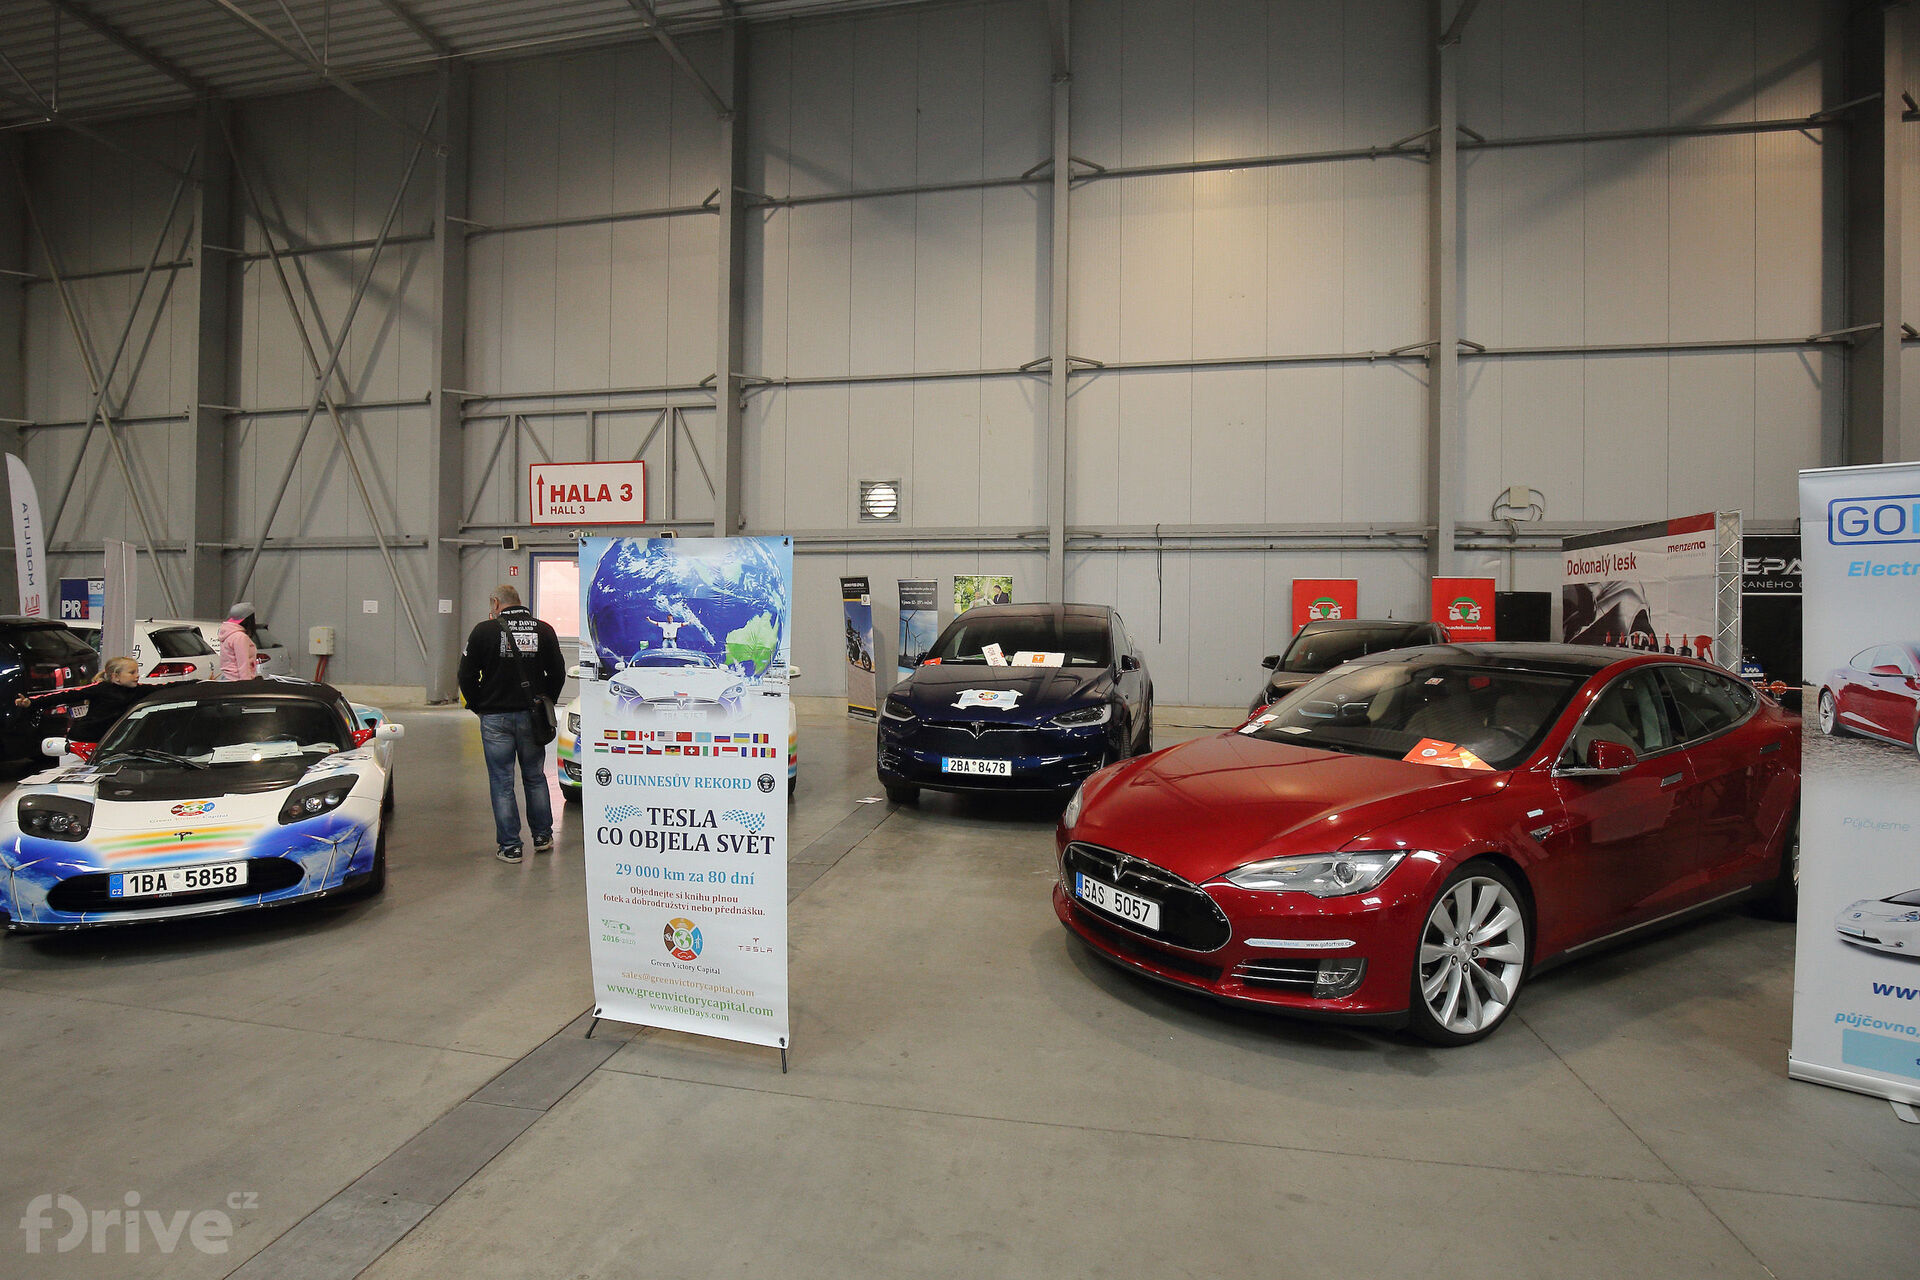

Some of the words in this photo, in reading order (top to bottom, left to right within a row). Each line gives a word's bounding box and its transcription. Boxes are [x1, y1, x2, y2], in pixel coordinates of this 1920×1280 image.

[550, 484, 612, 502] HALA
[620, 483, 633, 501] 3
[550, 505, 576, 514] HALL
[579, 505, 586, 514] 3
[1837, 503, 1920, 537] GO
[1667, 541, 1706, 553] menzerna
[1566, 552, 1610, 577] Dokonalý
[1612, 552, 1637, 572] lesk
[61, 600, 89, 618] PRE
[951, 760, 969, 772] 2BA
[979, 762, 1005, 774] 8478
[616, 773, 690, 788] GUINNESŮV
[694, 777, 752, 791] REKORD
[647, 807, 718, 829] TESLA
[597, 826, 623, 845] CO
[630, 829, 710, 854] OBJELA
[717, 830, 775, 855] SVĚT
[129, 873, 167, 893] 1BA
[185, 866, 237, 888] 5858
[615, 863, 632, 876] 29
[635, 865, 660, 879] 000
[663, 867, 685, 881] km
[688, 872, 704, 883] za
[708, 871, 726, 884] 80
[730, 872, 755, 885] dní
[603, 893, 624, 903] fotek
[631, 895, 689, 911] dobrodružství
[691, 903, 713, 913] nebo
[714, 904, 766, 916] přednášku.
[630, 886, 674, 899] Objednejte
[675, 891, 684, 900] si
[685, 892, 710, 902] knihu
[712, 893, 739, 904] plnou
[1084, 879, 1105, 905] 5AS
[1115, 893, 1150, 922] 5057
[738, 945, 773, 953] TESLA
[650, 958, 670, 969] Green
[672, 961, 696, 973] Victory
[696, 965, 721, 975] Capital
[621, 970, 755, 998] sales@greenvictorycapital.com
[606, 984, 774, 1017] www.greenvictorycapital.com
[650, 1002, 730, 1022] www.80eDays.com
